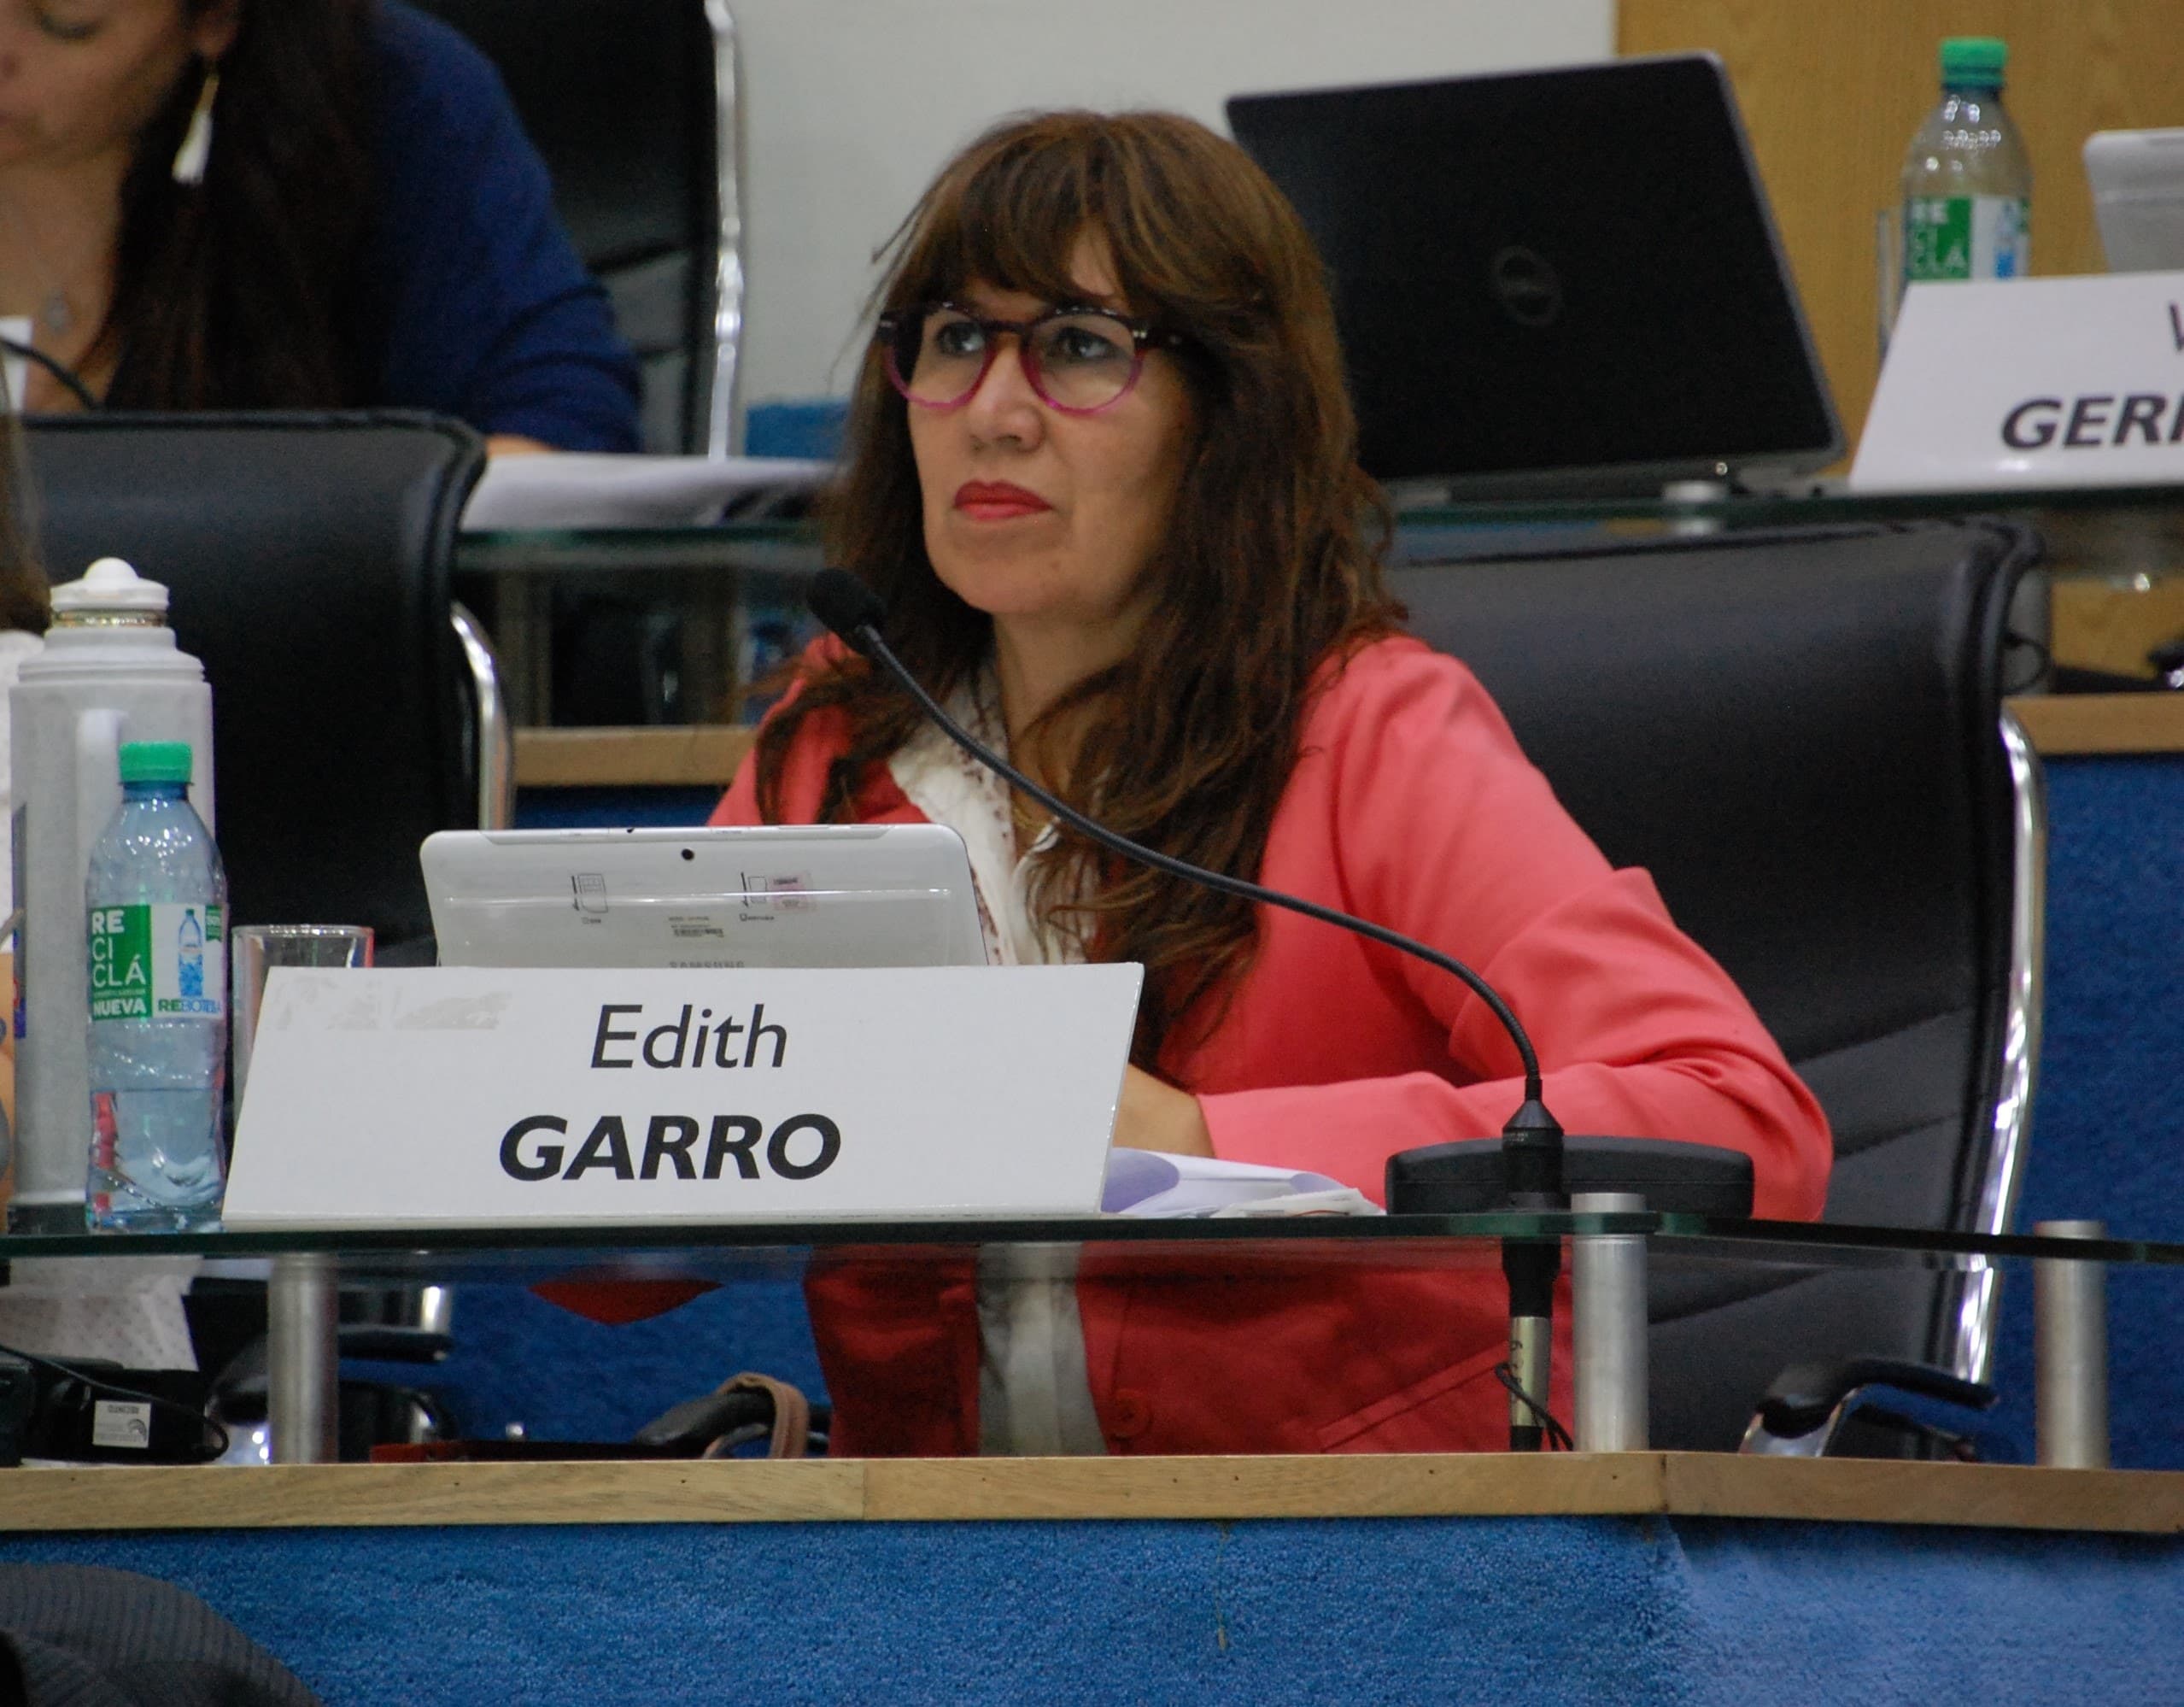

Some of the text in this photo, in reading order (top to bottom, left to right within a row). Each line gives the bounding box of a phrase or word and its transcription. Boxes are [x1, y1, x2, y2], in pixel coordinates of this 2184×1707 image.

[2000, 395, 2184, 449] GER
[91, 910, 126, 934] RE
[92, 937, 113, 962] CI
[92, 954, 147, 988] CLÁ
[94, 998, 147, 1017] NUEVA
[590, 1004, 788, 1069] Edith
[499, 1114, 841, 1182] GARRO
